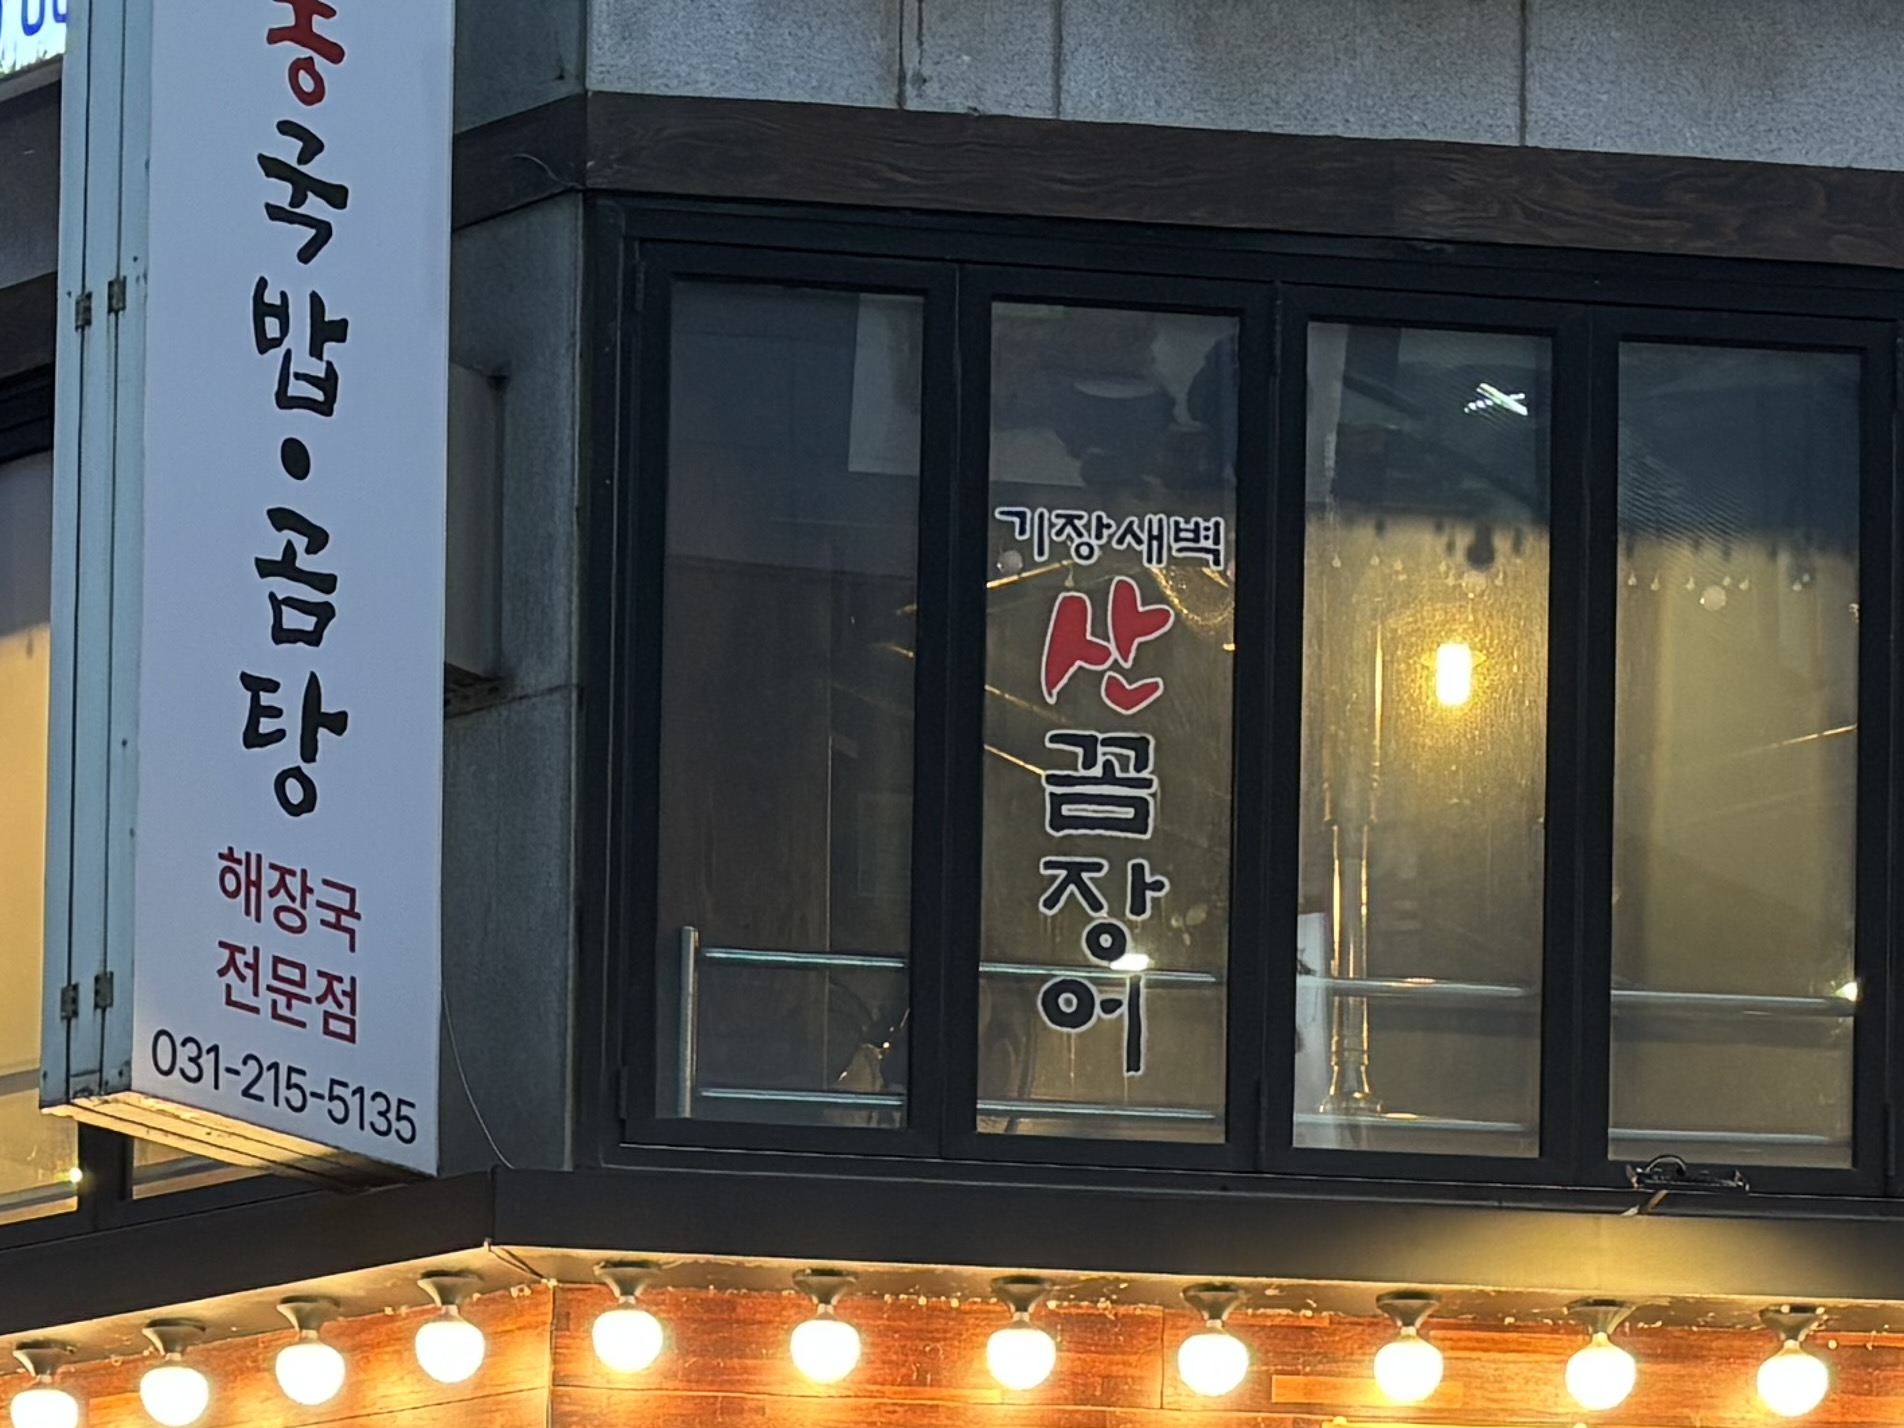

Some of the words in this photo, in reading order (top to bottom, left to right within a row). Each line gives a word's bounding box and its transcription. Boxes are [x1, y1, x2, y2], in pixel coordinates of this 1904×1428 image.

[994, 506, 1225, 569] 기장새벽
[1042, 577, 1174, 705] 산
[218, 846, 362, 953] 해장국
[1038, 730, 1169, 1076] 꼼장어
[217, 940, 358, 1044] 전문점
[151, 1028, 417, 1145] 031-215-5135
